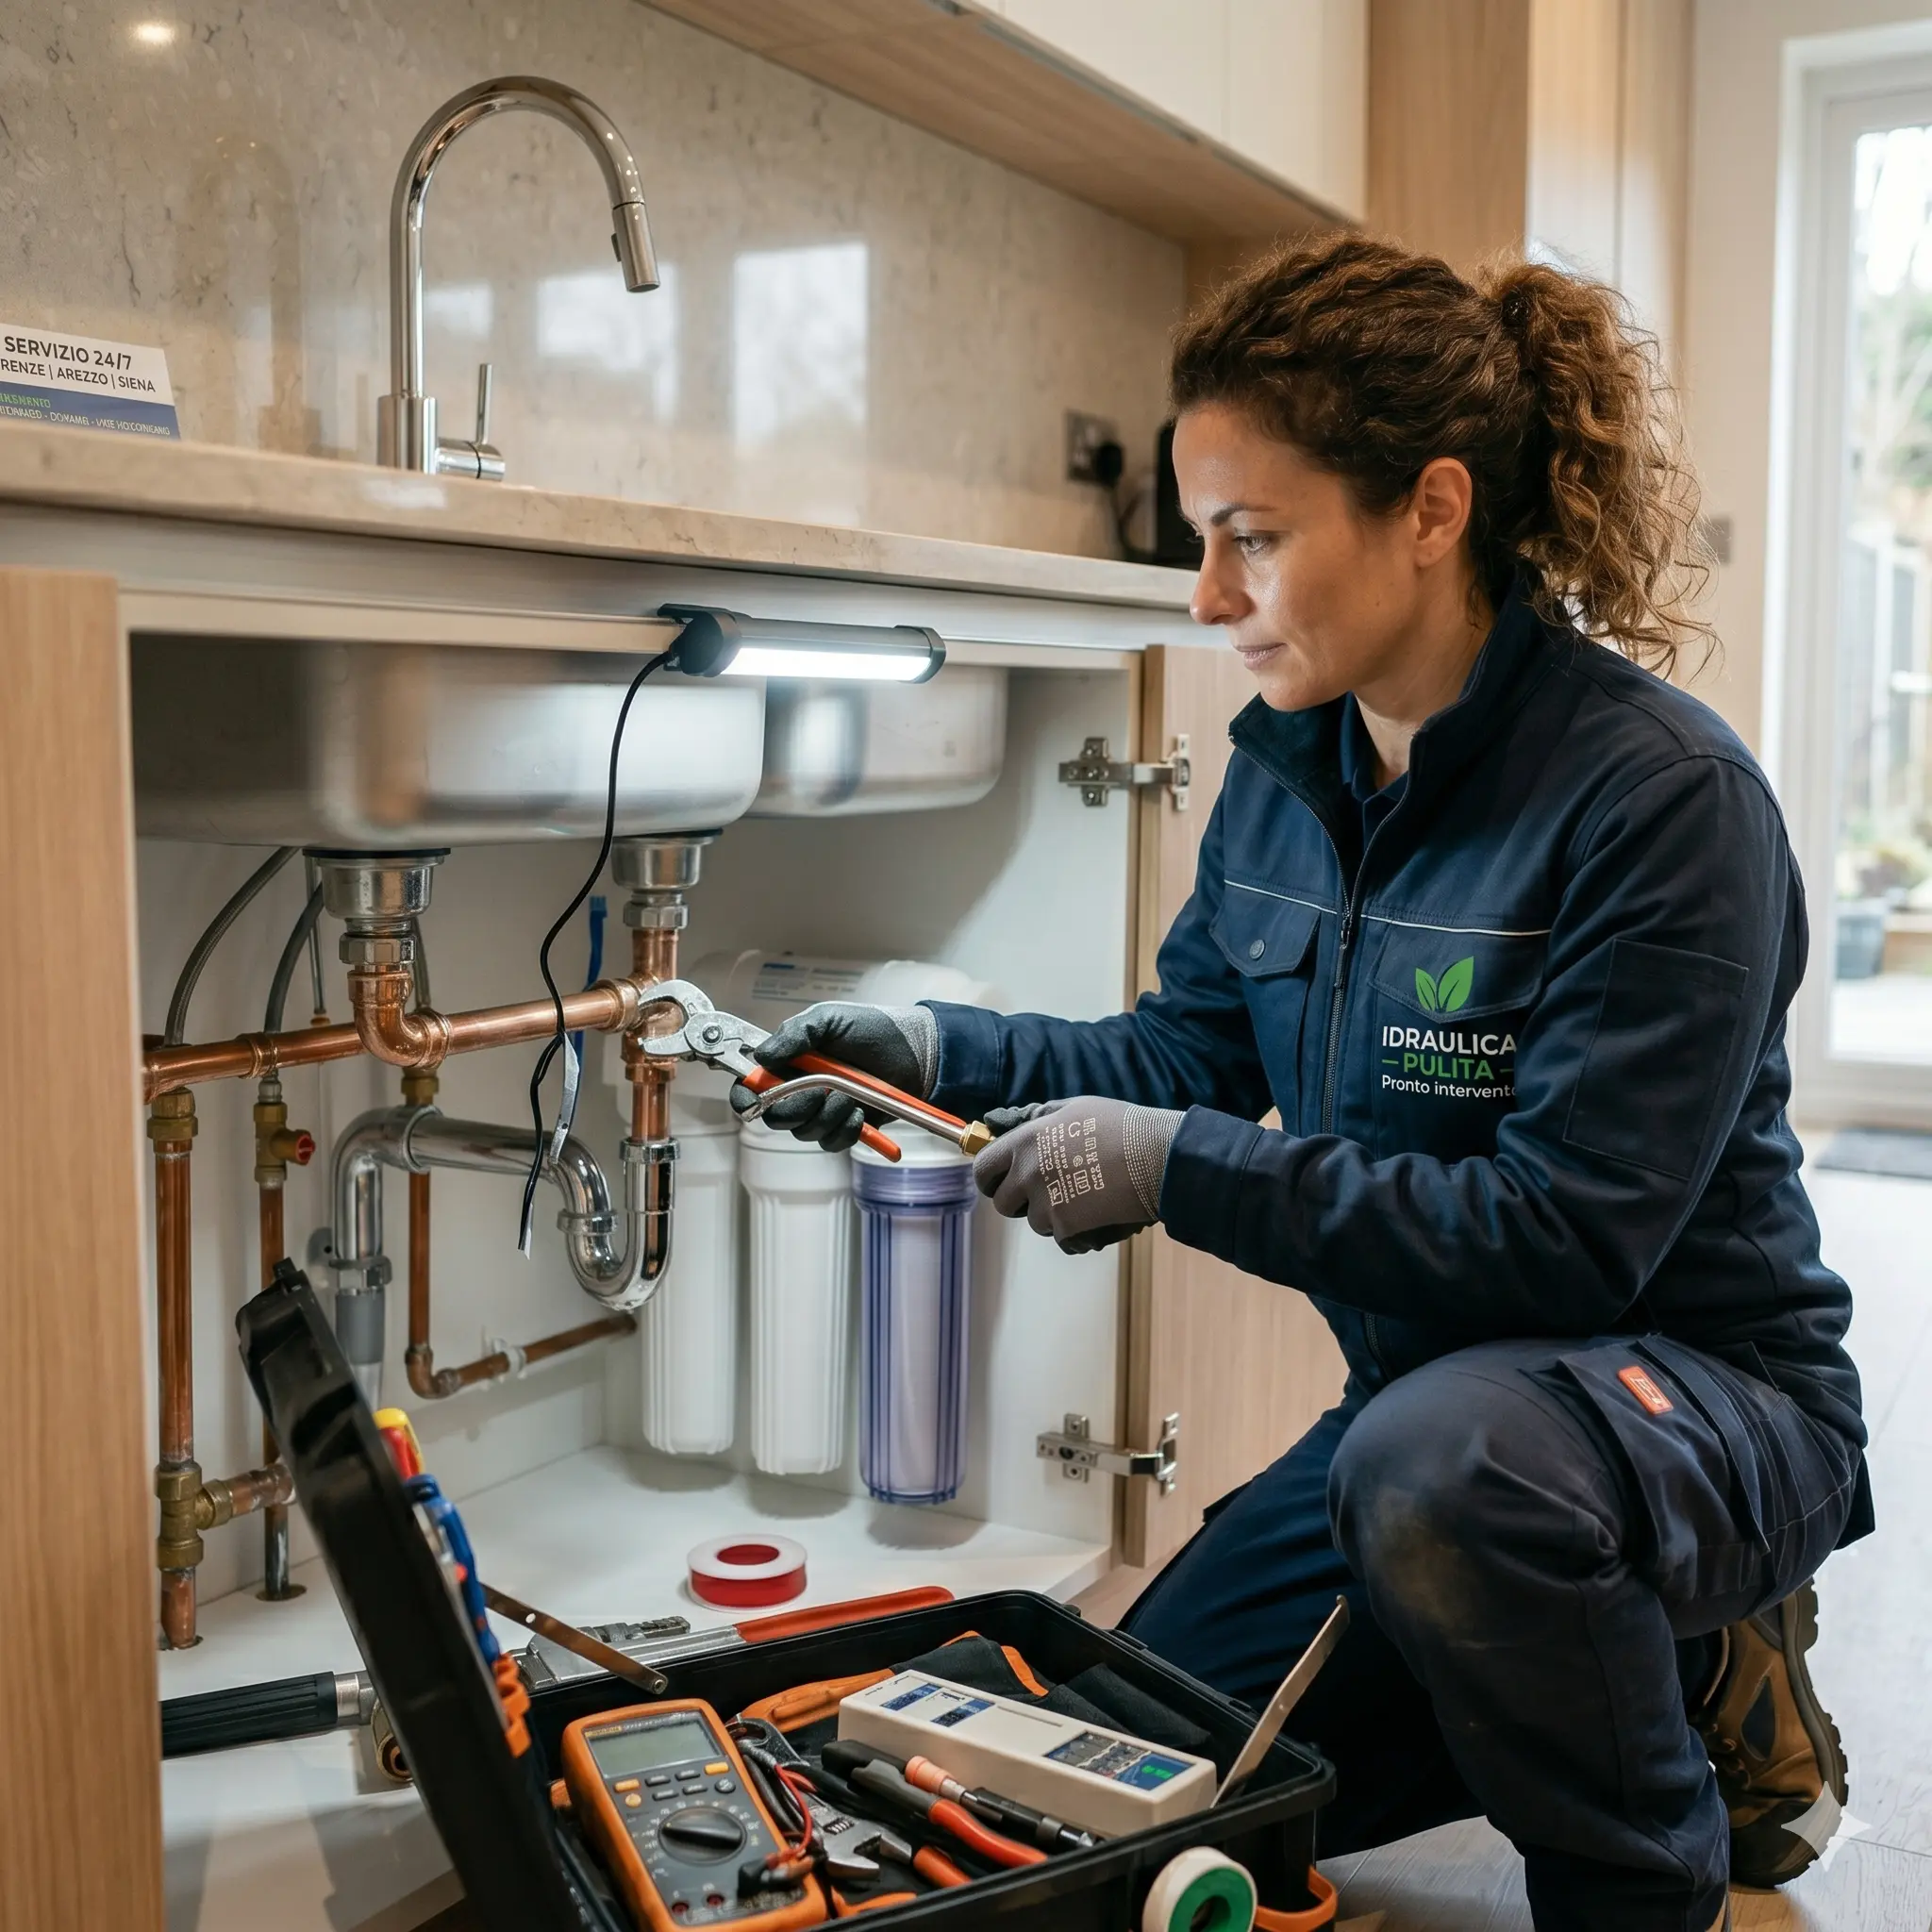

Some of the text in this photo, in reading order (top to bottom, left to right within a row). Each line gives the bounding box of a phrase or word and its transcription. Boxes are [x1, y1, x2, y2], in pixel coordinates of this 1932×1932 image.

[4, 336, 131, 370] SERVIZIO 24/7
[57, 367, 108, 385] AREZZO
[118, 375, 157, 392] SIENA
[1382, 1025, 1517, 1056] IDRAULICA
[1404, 1053, 1494, 1081] PULITA
[1382, 1074, 1430, 1093] Pronto
